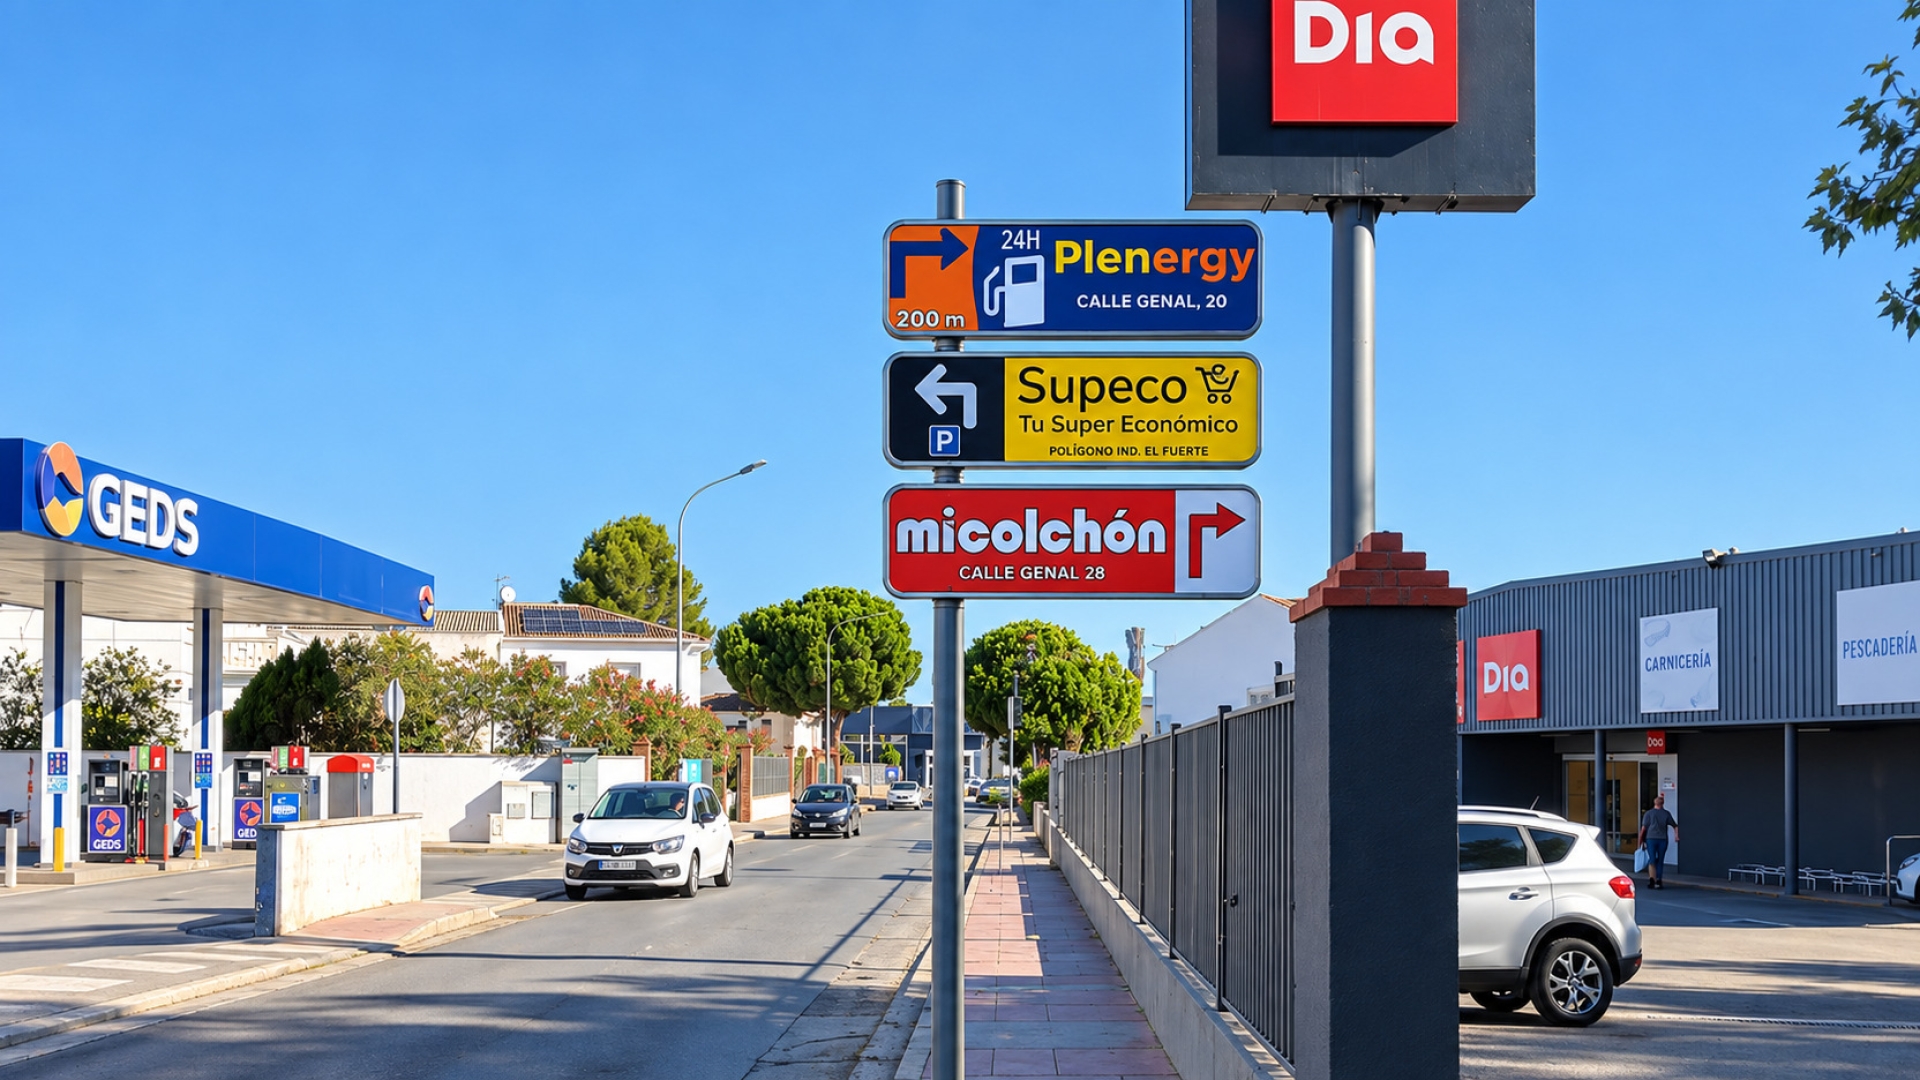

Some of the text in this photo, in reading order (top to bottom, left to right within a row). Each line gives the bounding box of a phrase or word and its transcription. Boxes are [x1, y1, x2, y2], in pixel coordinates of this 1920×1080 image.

[1294, 0, 1434, 65] Dia
[1001, 229, 1041, 250] 24H
[1055, 239, 1256, 283] Plenergy
[1076, 294, 1228, 310] CALLE GENAL, 20
[896, 310, 965, 328] 200 m
[1018, 366, 1187, 413] Supeco
[1018, 414, 1238, 437] Tu Super Económico
[937, 430, 953, 452] P
[1049, 443, 1209, 456] POLÍGONO IND. EL FUERTE
[88, 473, 199, 556] GEDS
[896, 506, 1167, 554] micolchón
[959, 566, 1105, 580] CALLE GENAL 28
[1842, 630, 1918, 659] PESCADERÍA
[1644, 648, 1712, 672] CARNICERÍA
[1483, 661, 1530, 694] Dia
[93, 838, 122, 850] GEDS
[237, 828, 257, 839] GED
